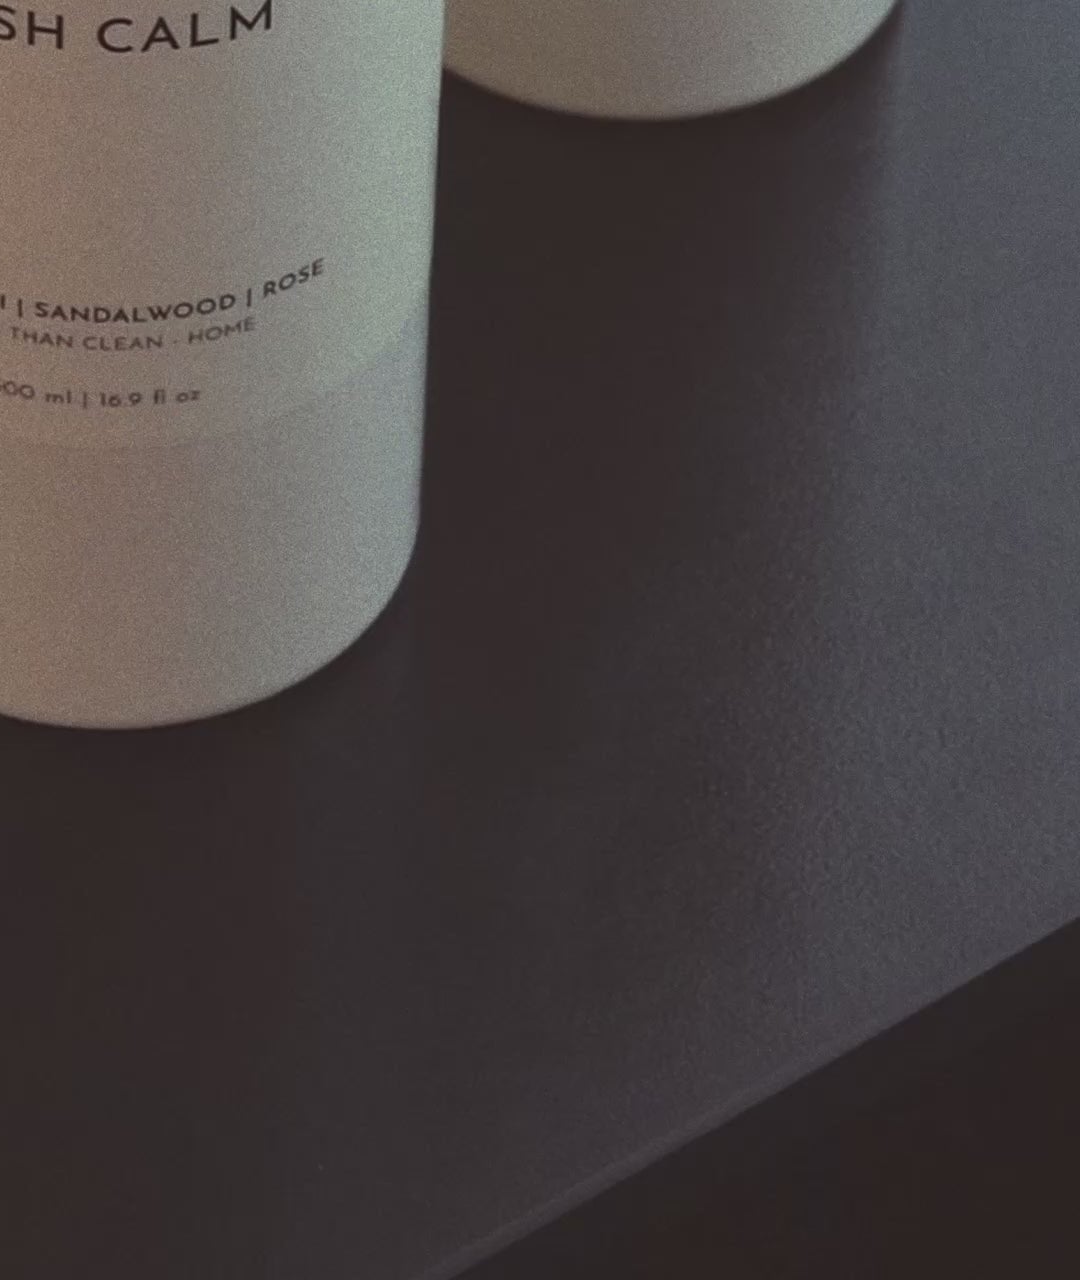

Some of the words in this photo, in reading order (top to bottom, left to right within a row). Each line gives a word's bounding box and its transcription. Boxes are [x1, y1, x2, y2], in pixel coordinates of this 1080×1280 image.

[34, 293, 237, 324] SANDALWOOD
[262, 257, 323, 298] ROSE
[11, 326, 74, 349] THAN
[82, 336, 164, 352] CLEAN
[187, 316, 254, 345] HOME
[44, 389, 73, 405] ml
